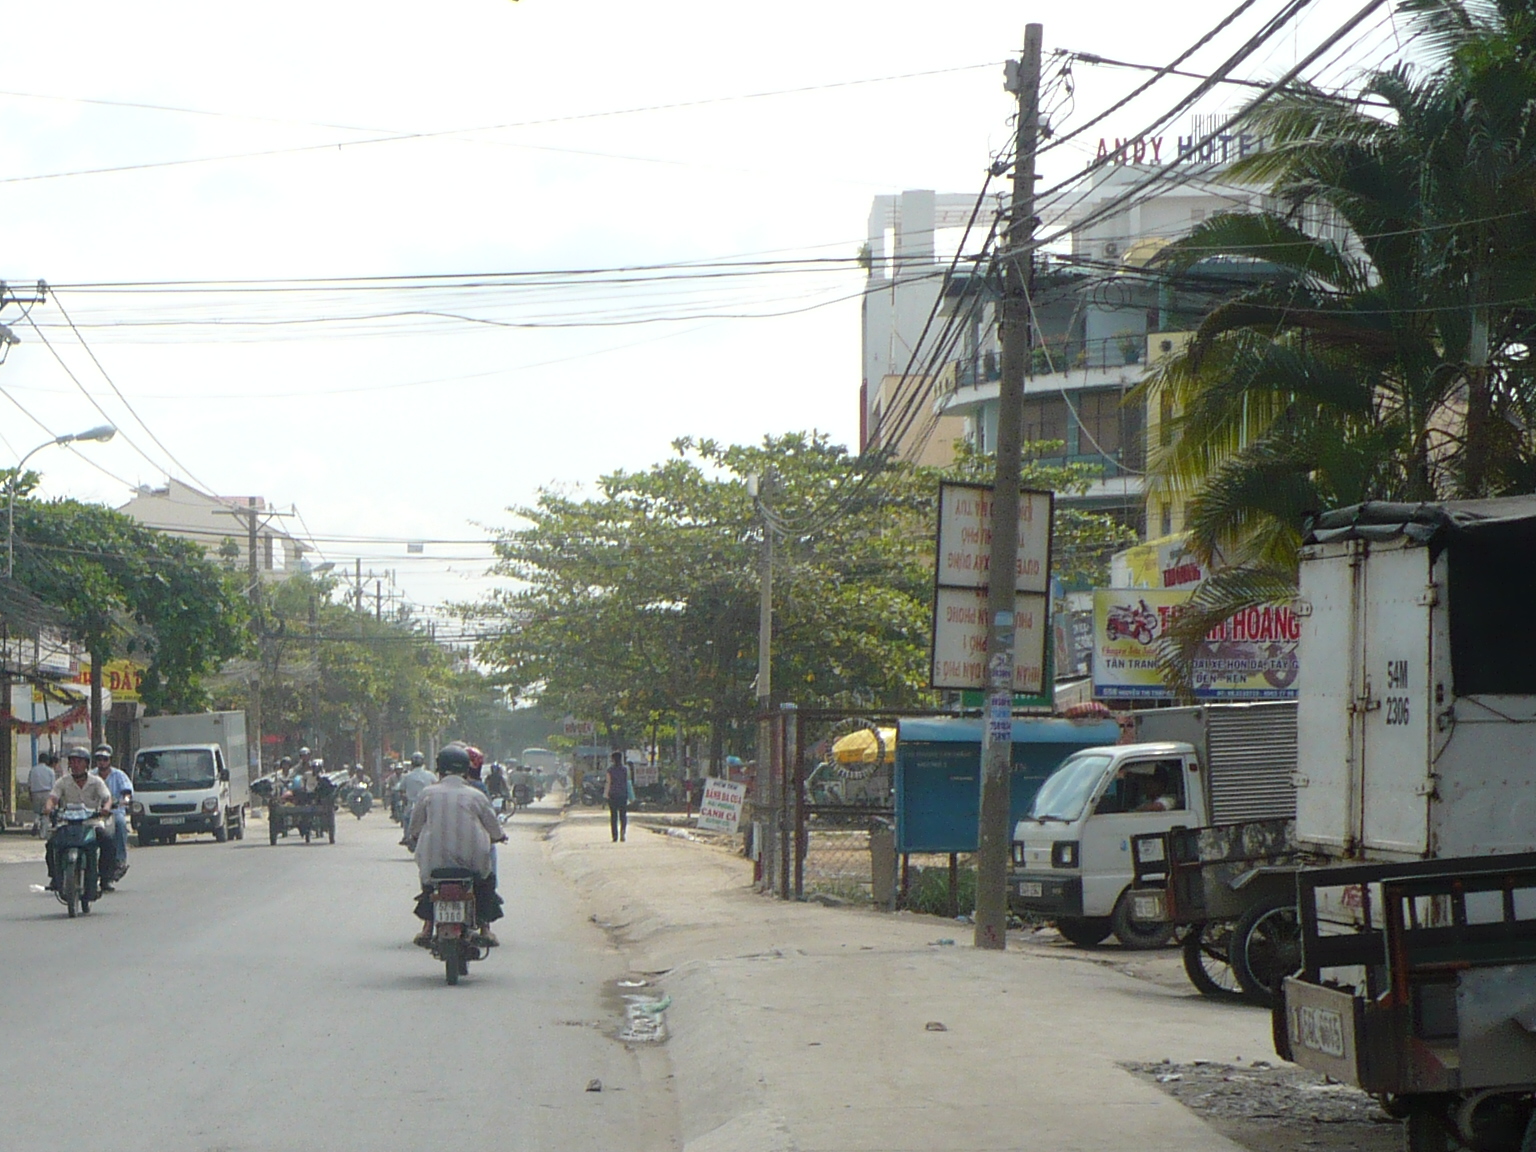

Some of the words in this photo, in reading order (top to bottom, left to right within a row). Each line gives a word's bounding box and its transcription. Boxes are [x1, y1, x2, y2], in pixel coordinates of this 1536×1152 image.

[1096, 135, 1164, 165] ANDY
[1387, 660, 1408, 689] 54M
[1386, 697, 1410, 726] 2306
[701, 807, 724, 819] CANH
